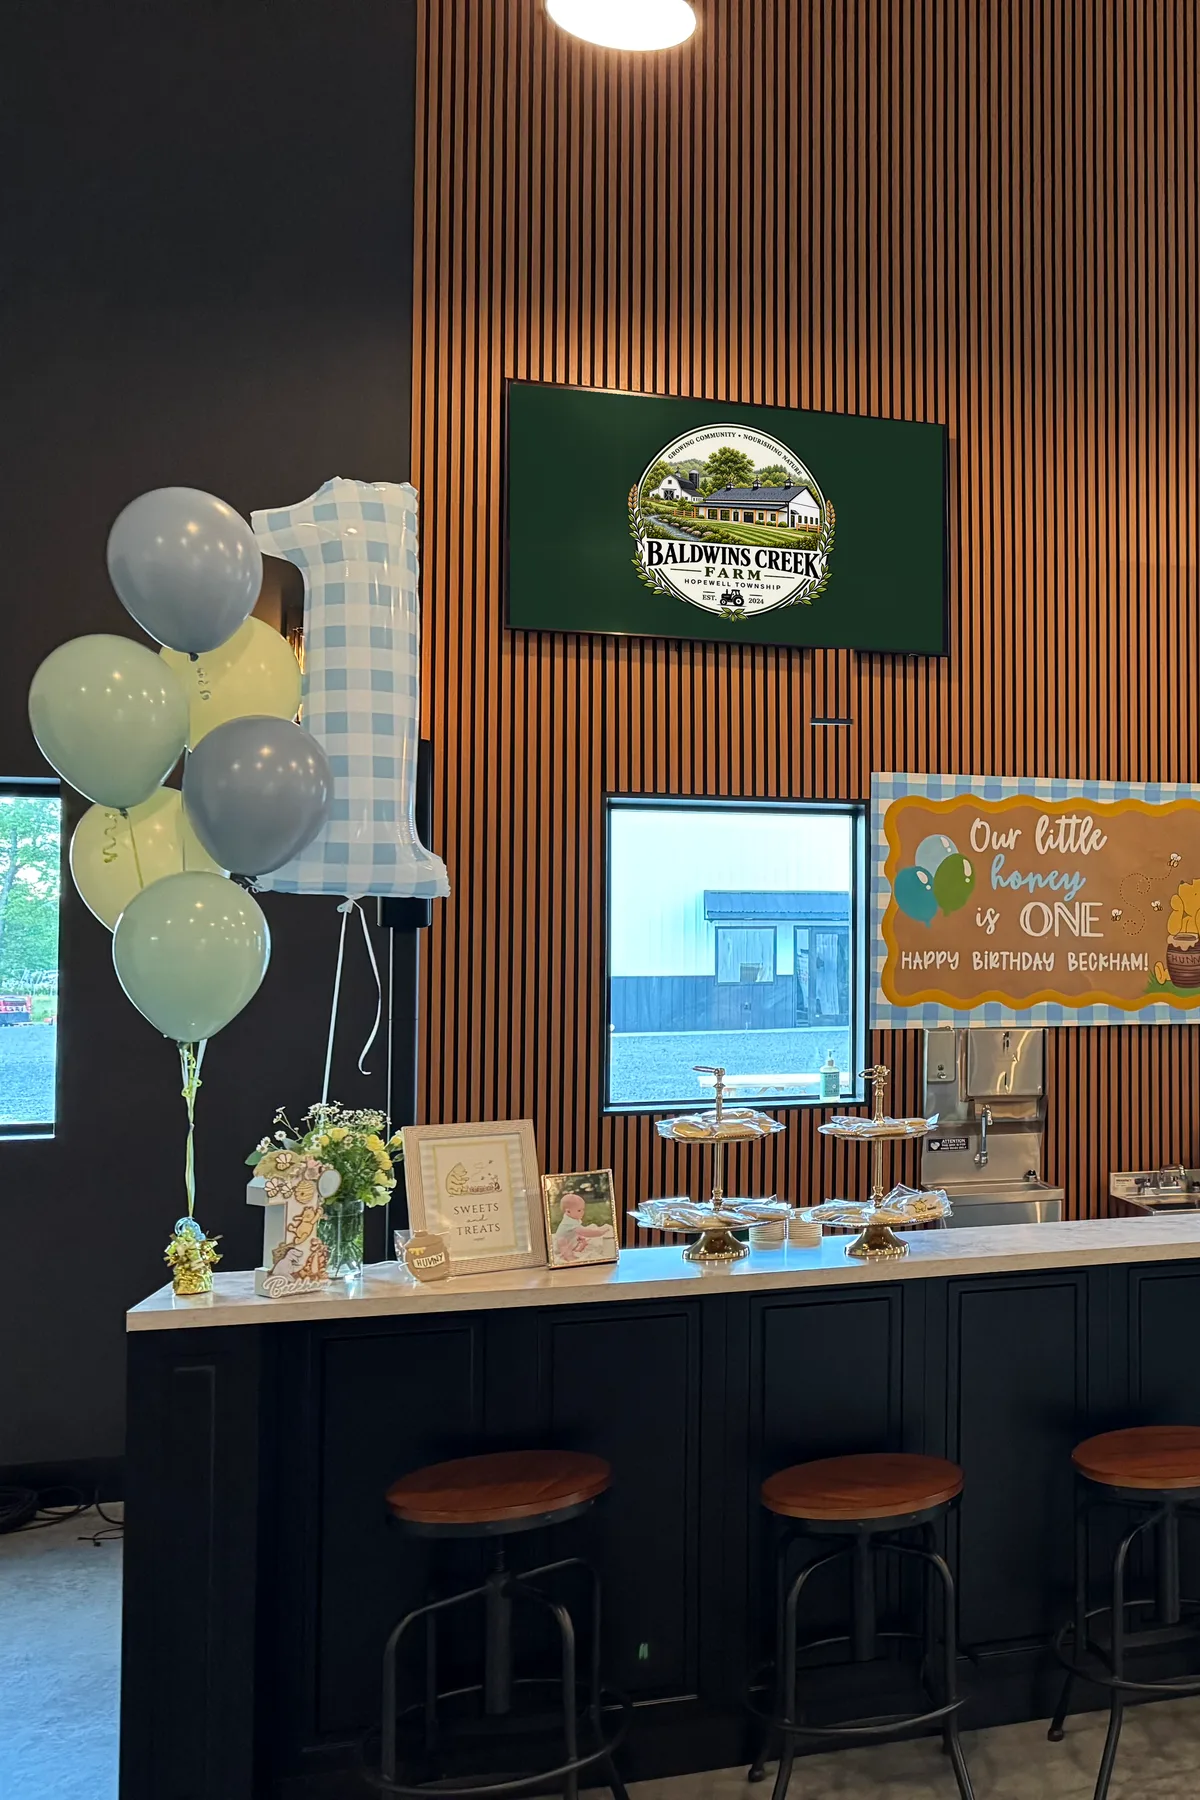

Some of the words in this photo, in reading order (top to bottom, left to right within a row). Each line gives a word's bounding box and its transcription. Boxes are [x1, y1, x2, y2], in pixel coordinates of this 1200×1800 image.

[667, 438, 695, 460] GROWING
[695, 431, 737, 443] COMMUNITY
[743, 433, 783, 457] NOURISHING
[781, 454, 803, 476] NATURE
[646, 540, 751, 567] BALDWINS
[754, 550, 821, 580] CREEK
[704, 566, 762, 581] FARM
[684, 578, 732, 588] HOPEWELL
[735, 582, 782, 591] TOWNSHIP
[702, 594, 718, 602] EST.
[748, 597, 765, 605] 2024
[969, 816, 1022, 853] Our
[1034, 813, 1108, 855] little
[990, 854, 1087, 901] honey
[975, 906, 1001, 936] is
[1018, 901, 1104, 938] ONE
[901, 950, 960, 971] HAPPY
[1067, 951, 1150, 972] BECKHAM!
[453, 1202, 500, 1216] SWEETS
[465, 1214, 488, 1223] and
[456, 1223, 501, 1236] TREATS
[416, 1254, 444, 1268] HUNNY
